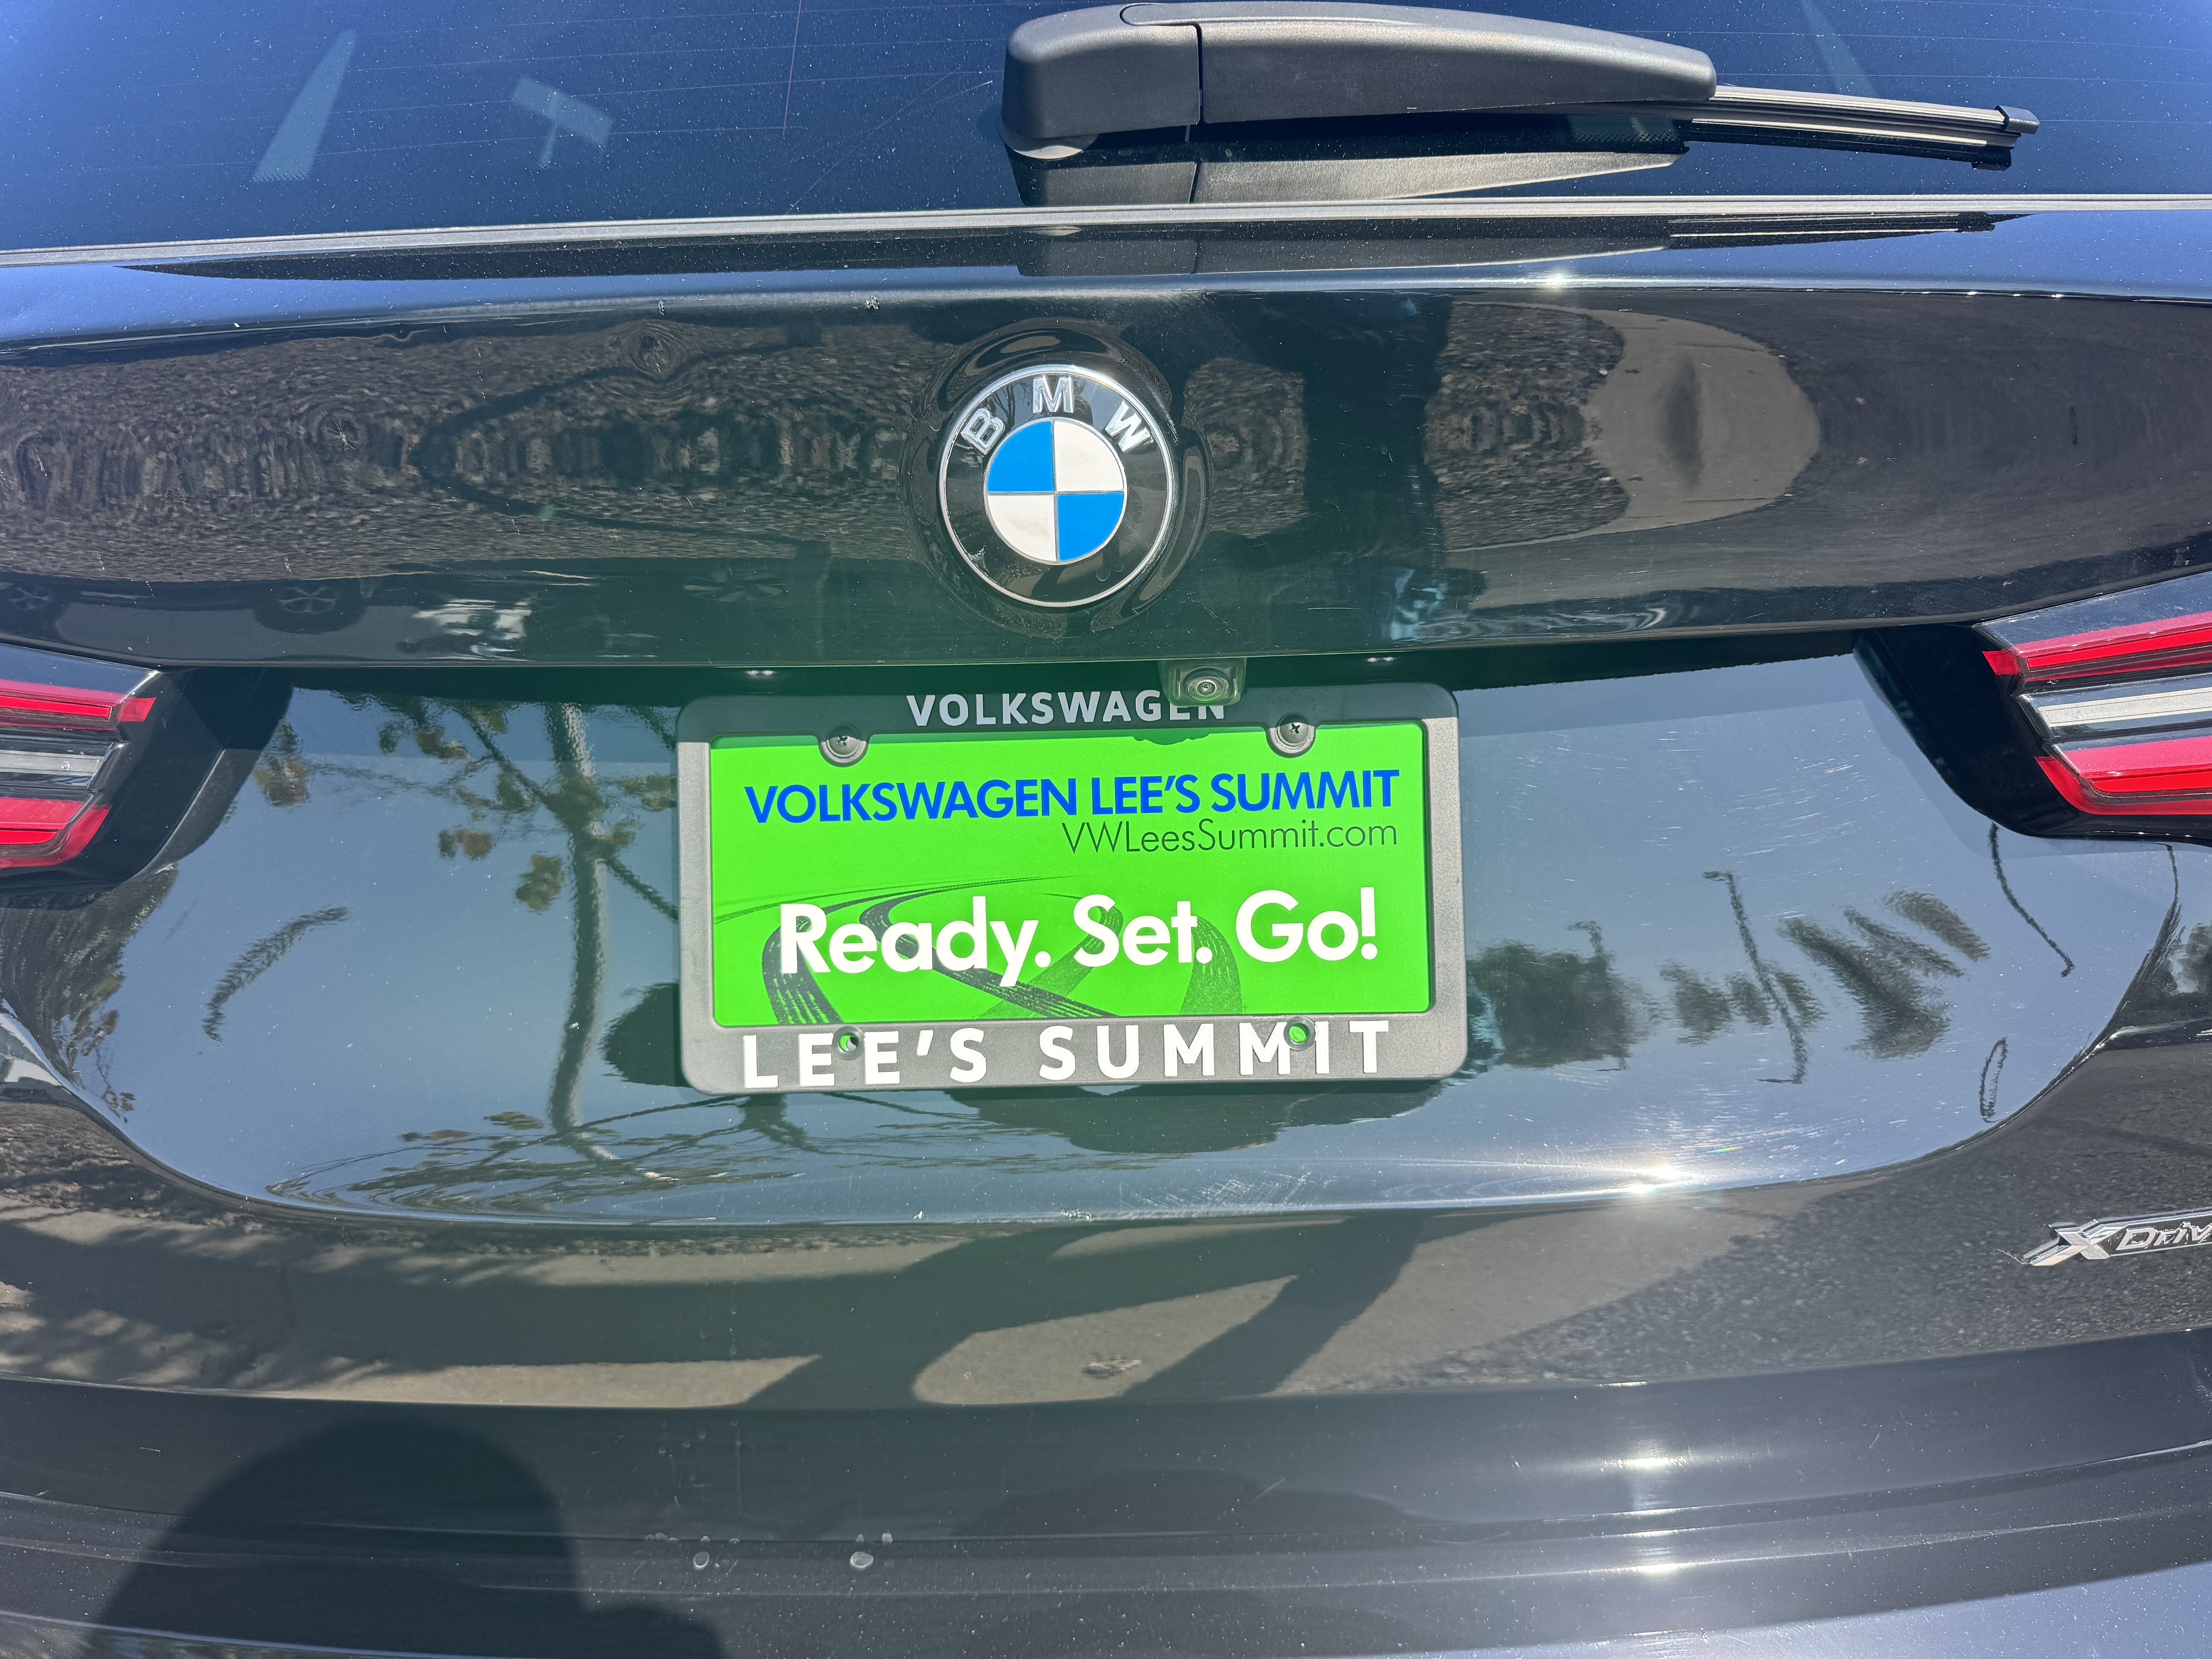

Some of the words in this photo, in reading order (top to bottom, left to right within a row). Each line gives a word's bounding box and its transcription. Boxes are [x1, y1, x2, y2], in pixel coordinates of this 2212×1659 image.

[961, 376, 1154, 455] BMW
[744, 778, 1077, 823] VOLKSWAGEN
[1092, 775, 1200, 815] LEE'S
[1211, 769, 1400, 812] SUMMIT
[1061, 818, 1397, 854] VWLeesSummit.com
[780, 896, 1051, 987] Ready.
[1073, 893, 1213, 967] Set.
[1235, 886, 1378, 963] Go!
[743, 1027, 987, 1089] LEE'S
[1039, 1020, 1389, 1081] SUMMIT
